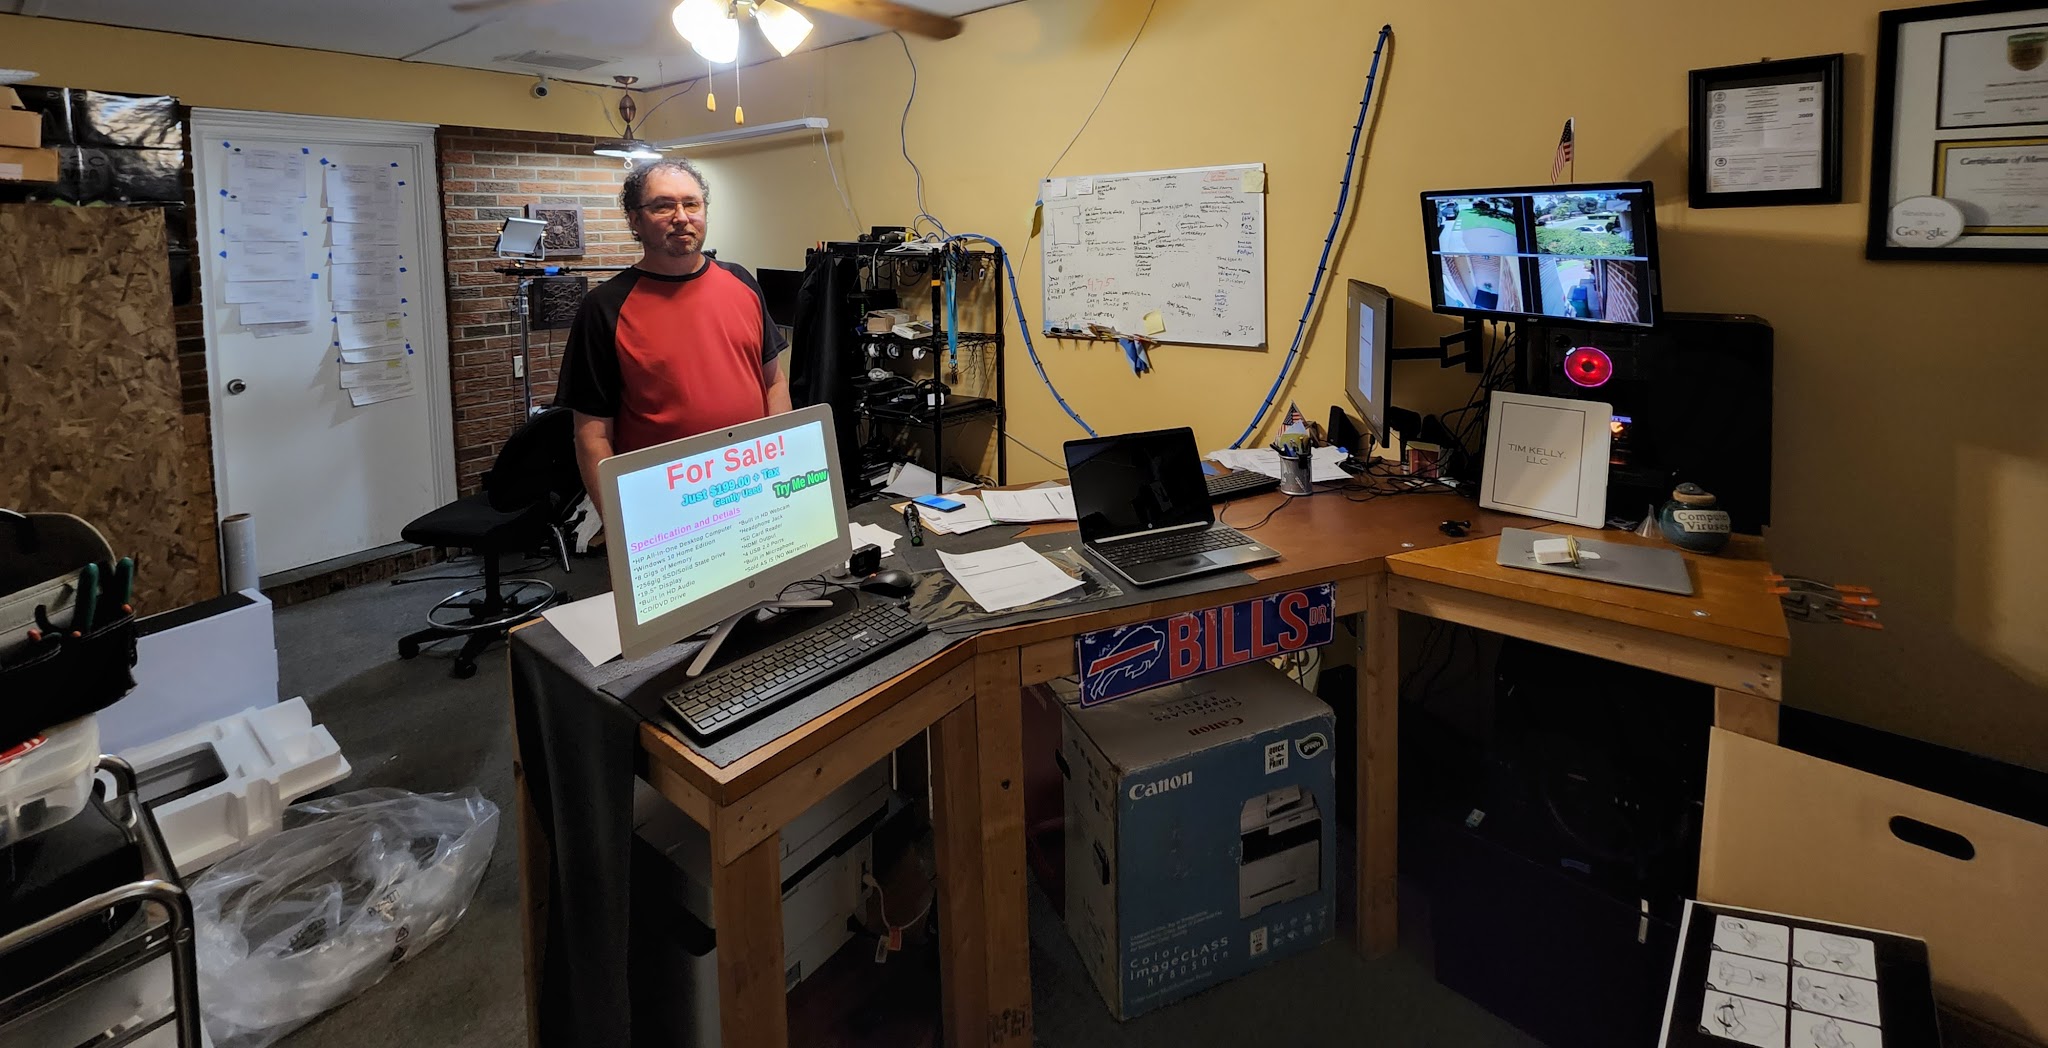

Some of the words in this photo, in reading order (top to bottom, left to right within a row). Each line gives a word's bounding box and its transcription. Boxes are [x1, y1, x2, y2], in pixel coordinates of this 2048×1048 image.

[1960, 156, 2008, 166] Certificate
[2010, 156, 2022, 164] of
[1896, 226, 1948, 240] Google
[1508, 443, 1526, 453] TIM
[666, 459, 714, 490] For
[723, 435, 785, 472] Sale!
[1526, 456, 1550, 466] LLC
[681, 488, 708, 506] Just
[709, 475, 751, 498] $199.00
[752, 473, 760, 482] +
[761, 466, 780, 480] Tax
[774, 481, 790, 497] Try
[791, 476, 806, 488] Me
[807, 470, 828, 484] Now
[713, 493, 740, 508] Gently
[742, 484, 763, 498] Used
[770, 504, 790, 515] Webcam
[771, 514, 784, 523] Jack
[1686, 522, 1728, 530] Viruses
[630, 524, 692, 552] Specification
[694, 517, 710, 529] and
[712, 507, 741, 522] Detials
[679, 535, 704, 549] Desktop
[705, 525, 732, 540] Computer
[751, 530, 764, 539] Card
[765, 523, 783, 533] Reader
[749, 546, 761, 555] USB
[770, 537, 784, 546] Ports
[759, 533, 777, 544] Output
[676, 547, 694, 558] Home
[695, 539, 716, 550] Edition
[765, 541, 794, 556] Microphone
[785, 542, 809, 556] Warranty)
[643, 570, 659, 580] Gigs
[668, 556, 693, 569] Memory
[662, 564, 693, 580] SSD/Solid
[694, 558, 710, 568] State
[710, 551, 726, 561] Drive
[658, 577, 683, 590] Display
[677, 579, 696, 591] Audio
[670, 592, 686, 603] Drive
[1168, 592, 1309, 680] BILLS
[1309, 604, 1331, 626] DR.
[1188, 717, 1244, 736] Canon
[1269, 744, 1285, 754] QUICK
[1269, 758, 1284, 770] PRINT
[1128, 770, 1193, 800] Canon
